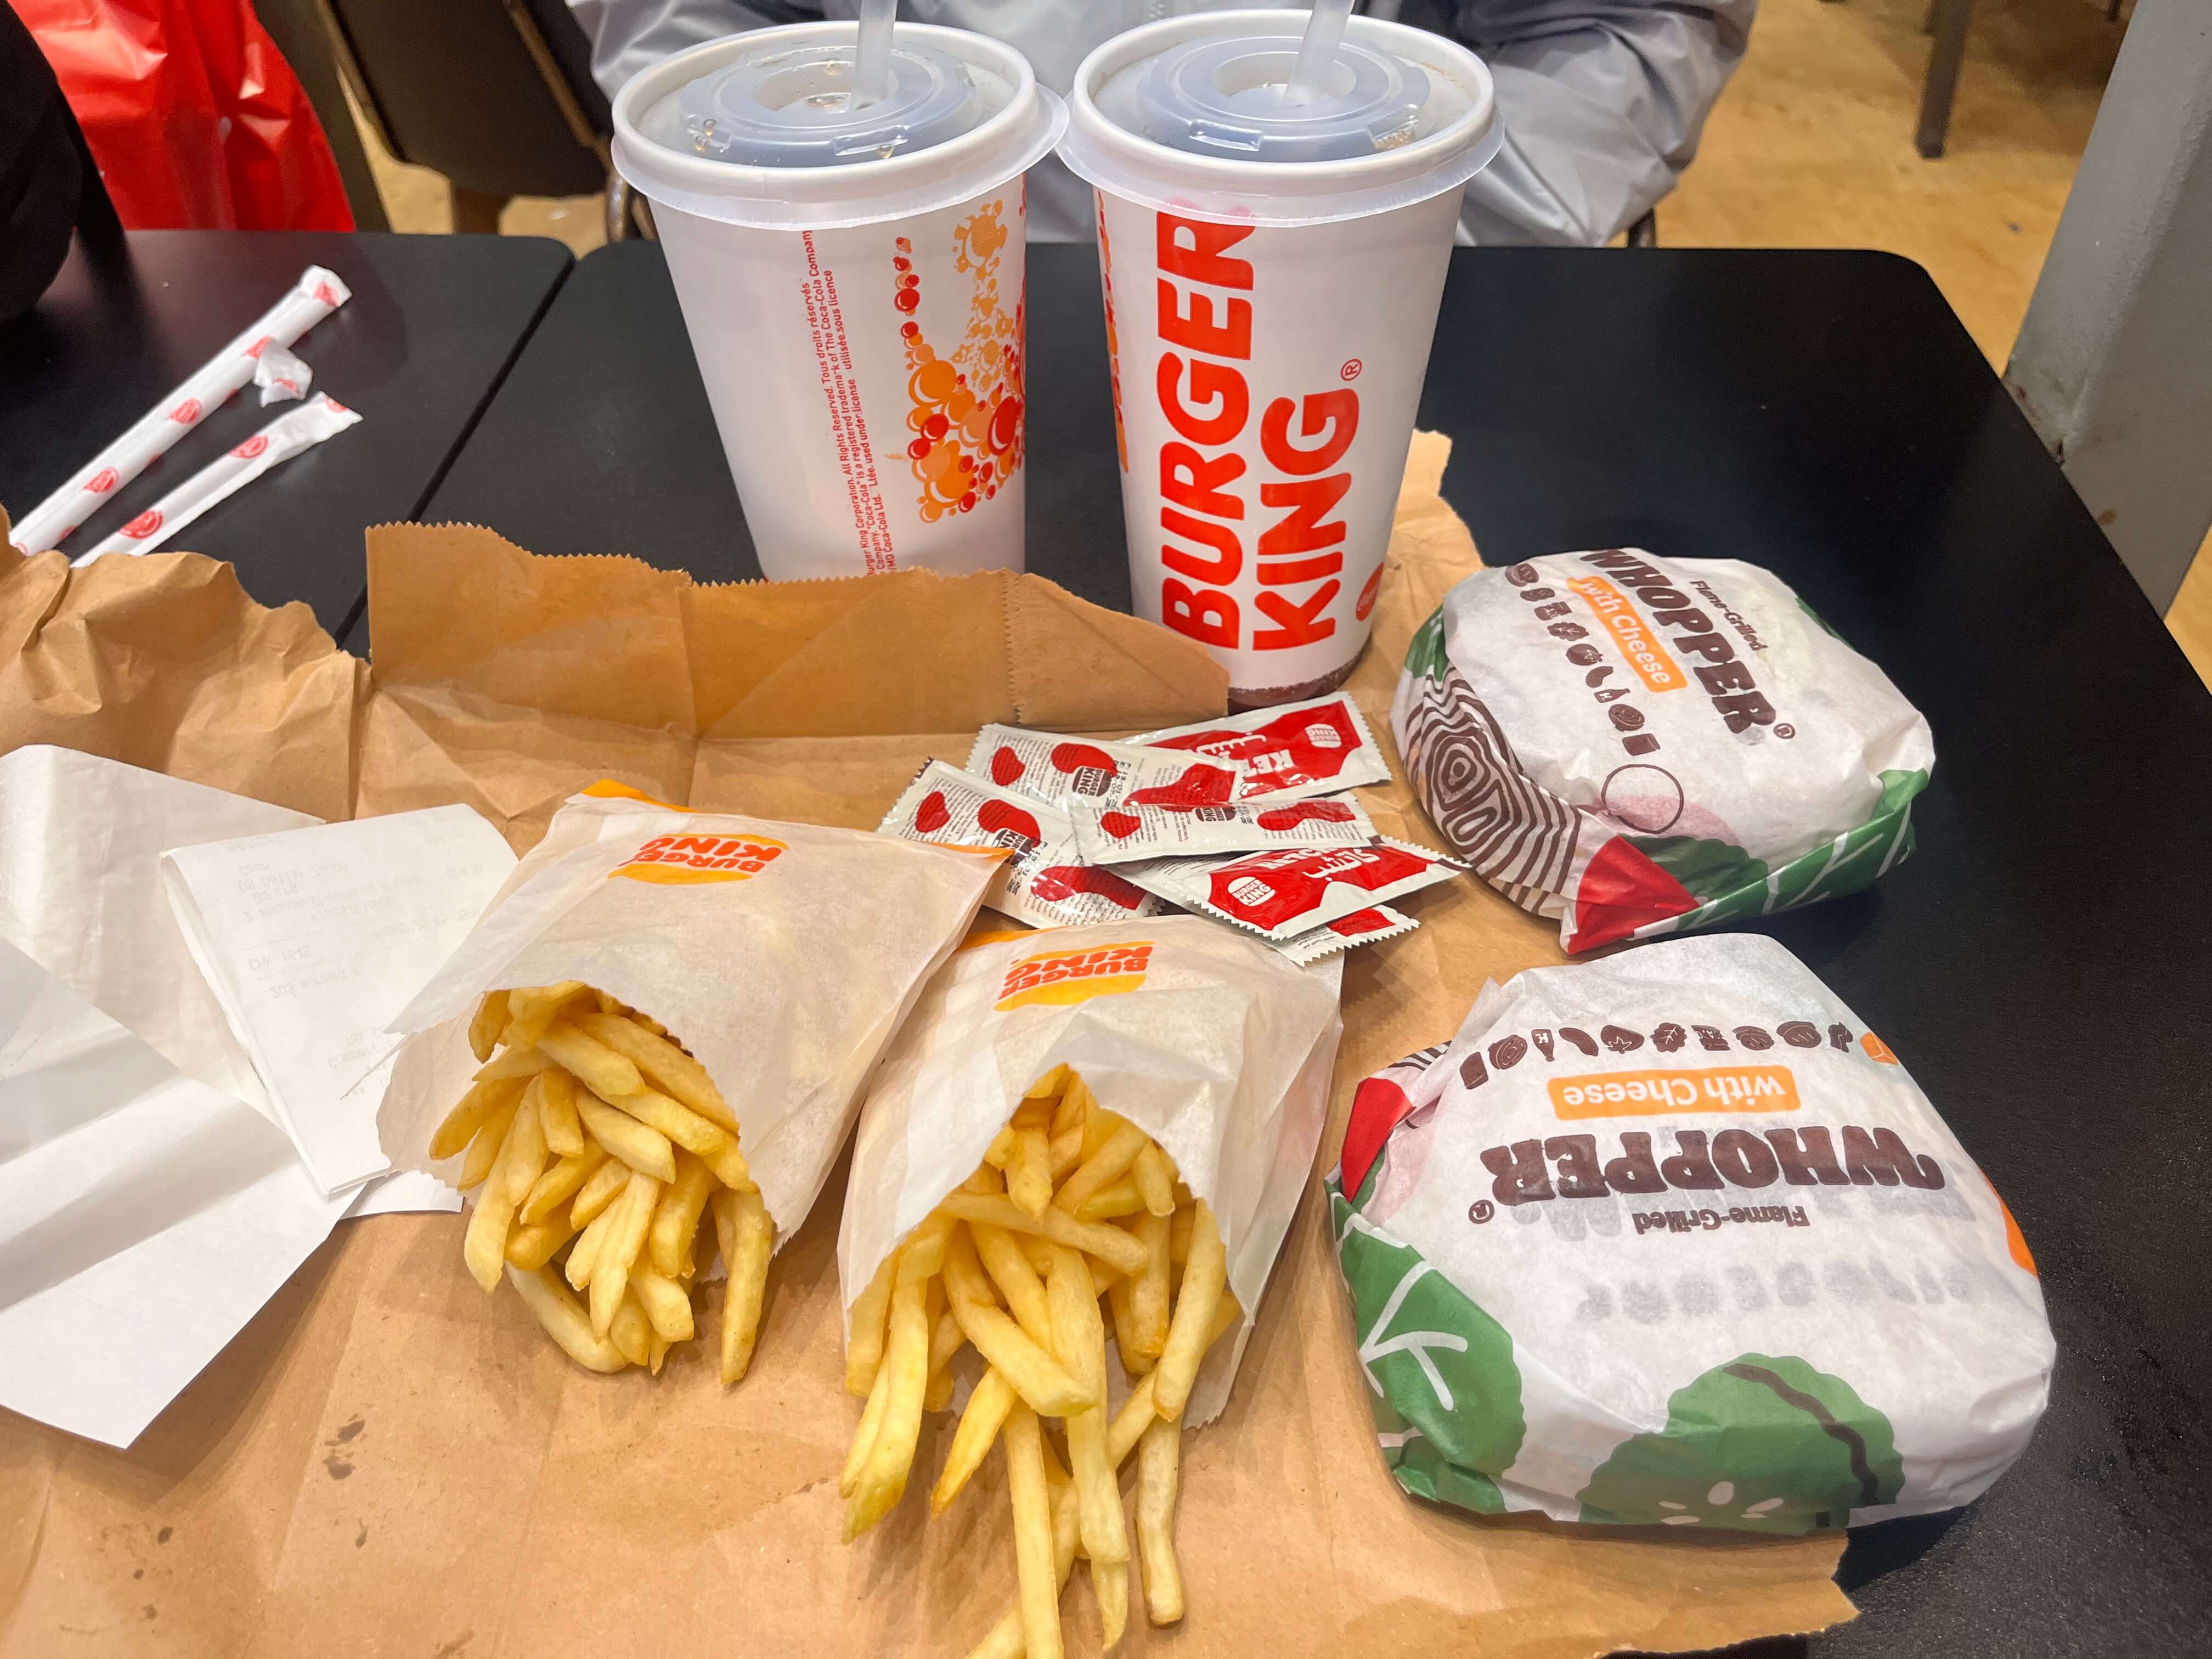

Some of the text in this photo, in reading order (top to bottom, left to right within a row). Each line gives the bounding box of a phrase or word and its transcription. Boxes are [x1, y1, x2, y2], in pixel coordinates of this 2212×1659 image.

[823, 270, 838, 306] licence
[800, 283, 818, 327] réservés
[812, 280, 831, 330] Coca-Cola
[832, 309, 844, 332] sous
[812, 330, 825, 358] droits
[826, 333, 835, 351] The
[837, 334, 852, 370] utilisée
[820, 361, 831, 384] Tous
[827, 353, 838, 362] of
[824, 386, 842, 431] Reserved.
[848, 379, 861, 412] license
[841, 416, 860, 461] registered
[855, 415, 868, 440] under
[1156, 207, 1256, 650] BURGER
[836, 433, 849, 461] Rights
[861, 443, 873, 464] used
[842, 464, 852, 475] All
[847, 477, 864, 528] Corporation.
[873, 494, 883, 510] Ltd.
[860, 531, 869, 548] King
[877, 512, 892, 552] Coca-Cola
[1690, 580, 1768, 651] Flame-Grilled
[1579, 582, 1672, 684] with Cheese
[1077, 768, 1092, 796] KING
[639, 838, 782, 861] KING
[1233, 879, 1263, 899] BURGER
[1238, 883, 1272, 906] KING
[1005, 946, 1153, 980] KING
[997, 958, 1148, 1000] BURGER
[1564, 1073, 1786, 1111] with Cheese
[1632, 1205, 1811, 1235] Flame-Grilled
